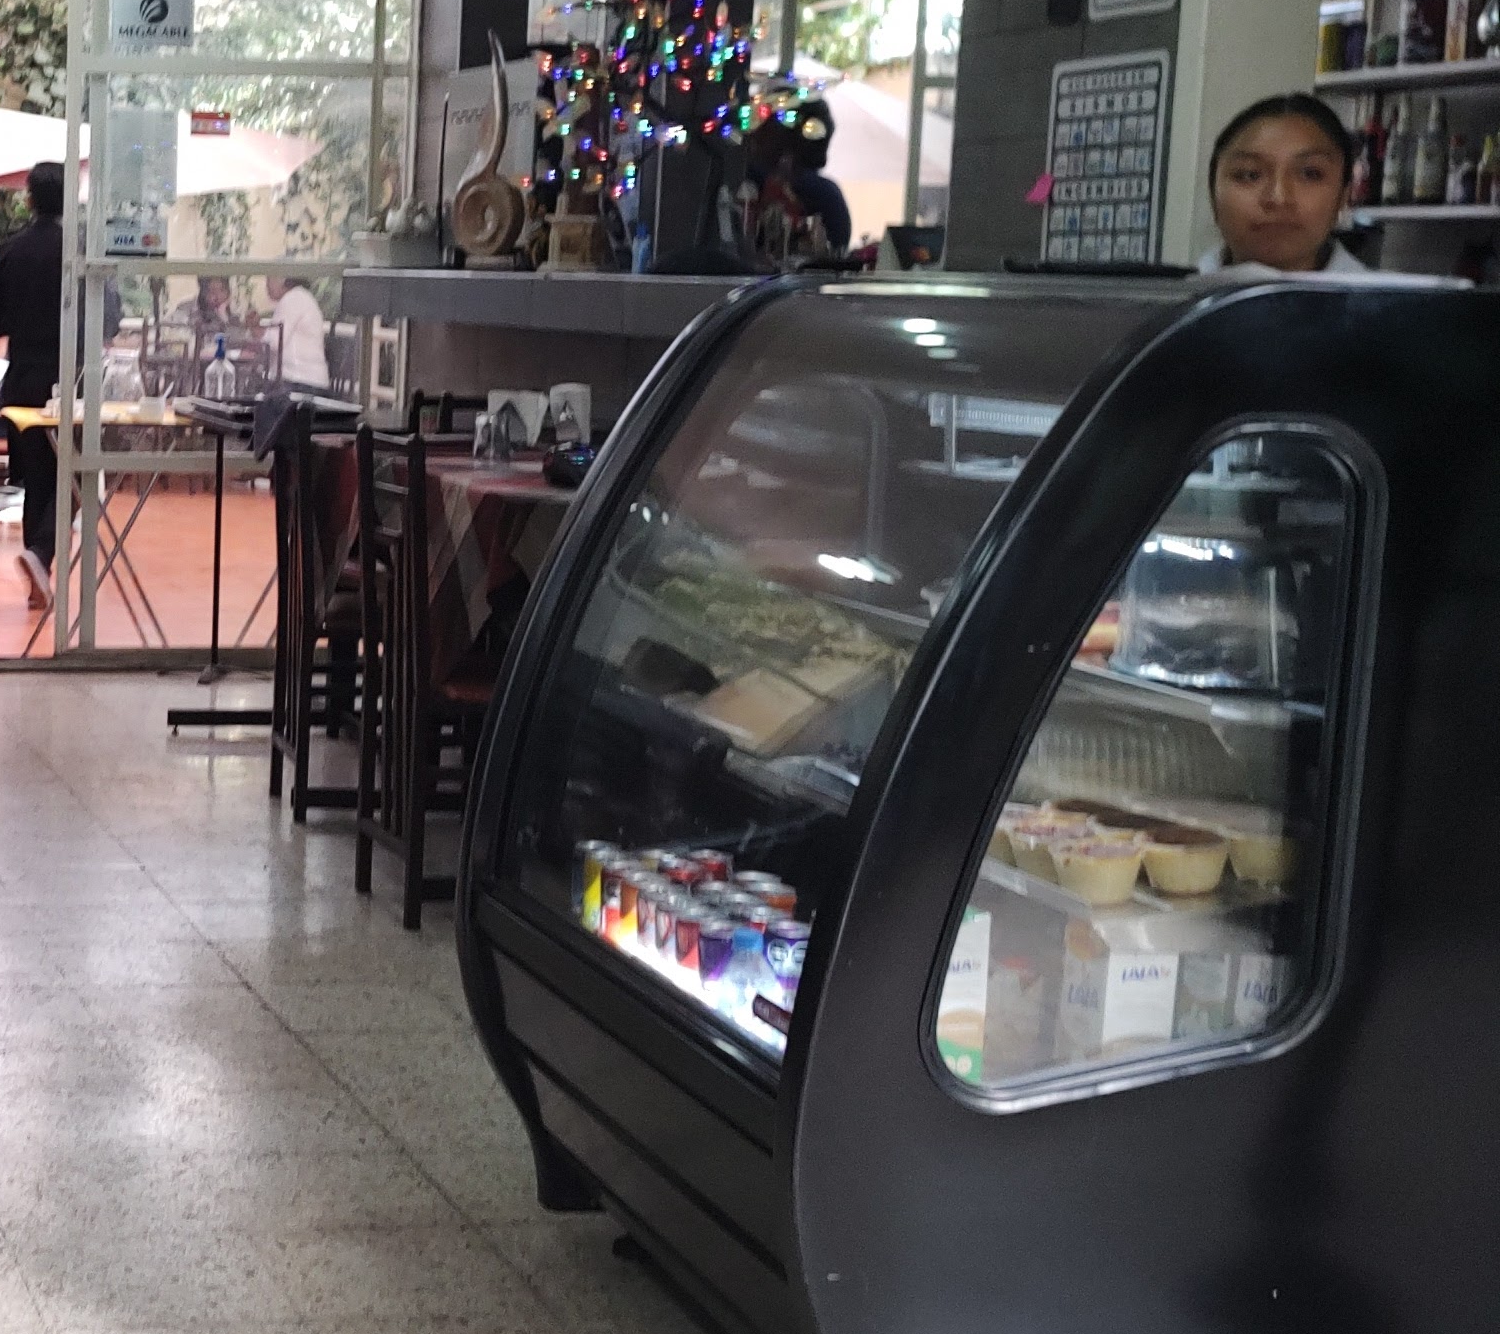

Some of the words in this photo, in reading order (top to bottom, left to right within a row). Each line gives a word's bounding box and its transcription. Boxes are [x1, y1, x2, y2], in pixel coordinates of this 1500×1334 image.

[118, 25, 189, 38] MEGACABLE
[113, 235, 135, 245] VISA
[1122, 965, 1160, 982] LALA
